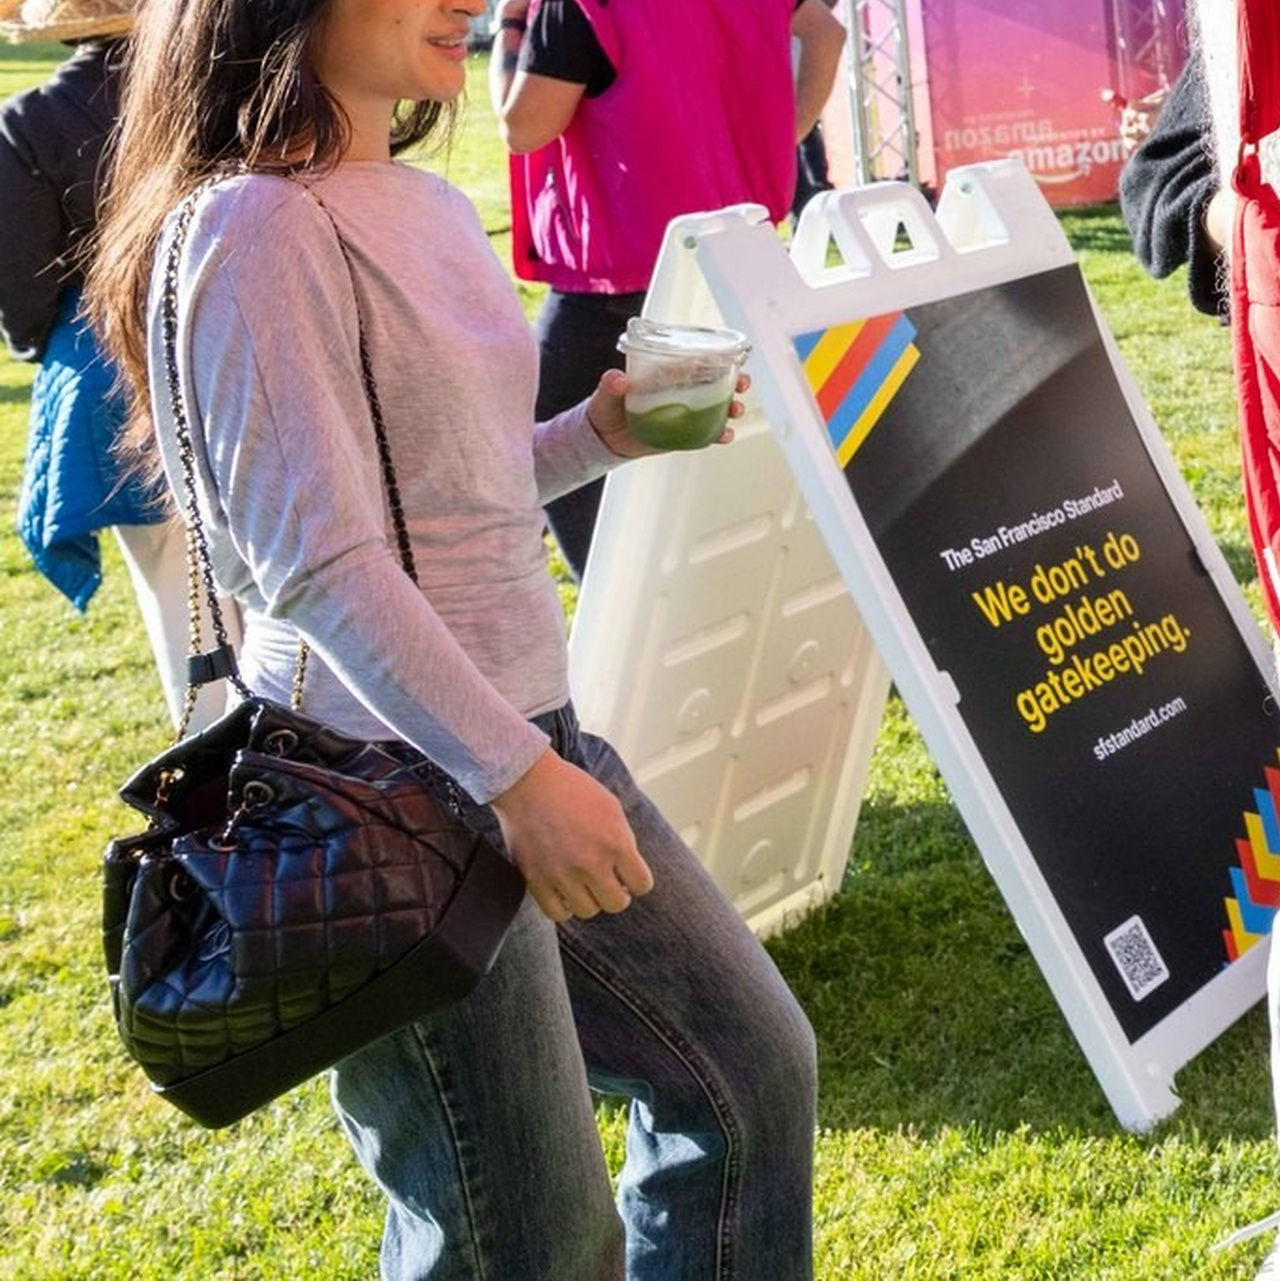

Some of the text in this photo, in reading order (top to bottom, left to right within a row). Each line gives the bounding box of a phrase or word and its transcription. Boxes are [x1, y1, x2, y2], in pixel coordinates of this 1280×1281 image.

[940, 479, 1125, 571] The San Francisco Standard
[972, 531, 1141, 628] We don't do
[1036, 589, 1134, 665] golden
[1016, 614, 1192, 733] gatekeeping.
[1093, 697, 1187, 761] sfstandard.com
